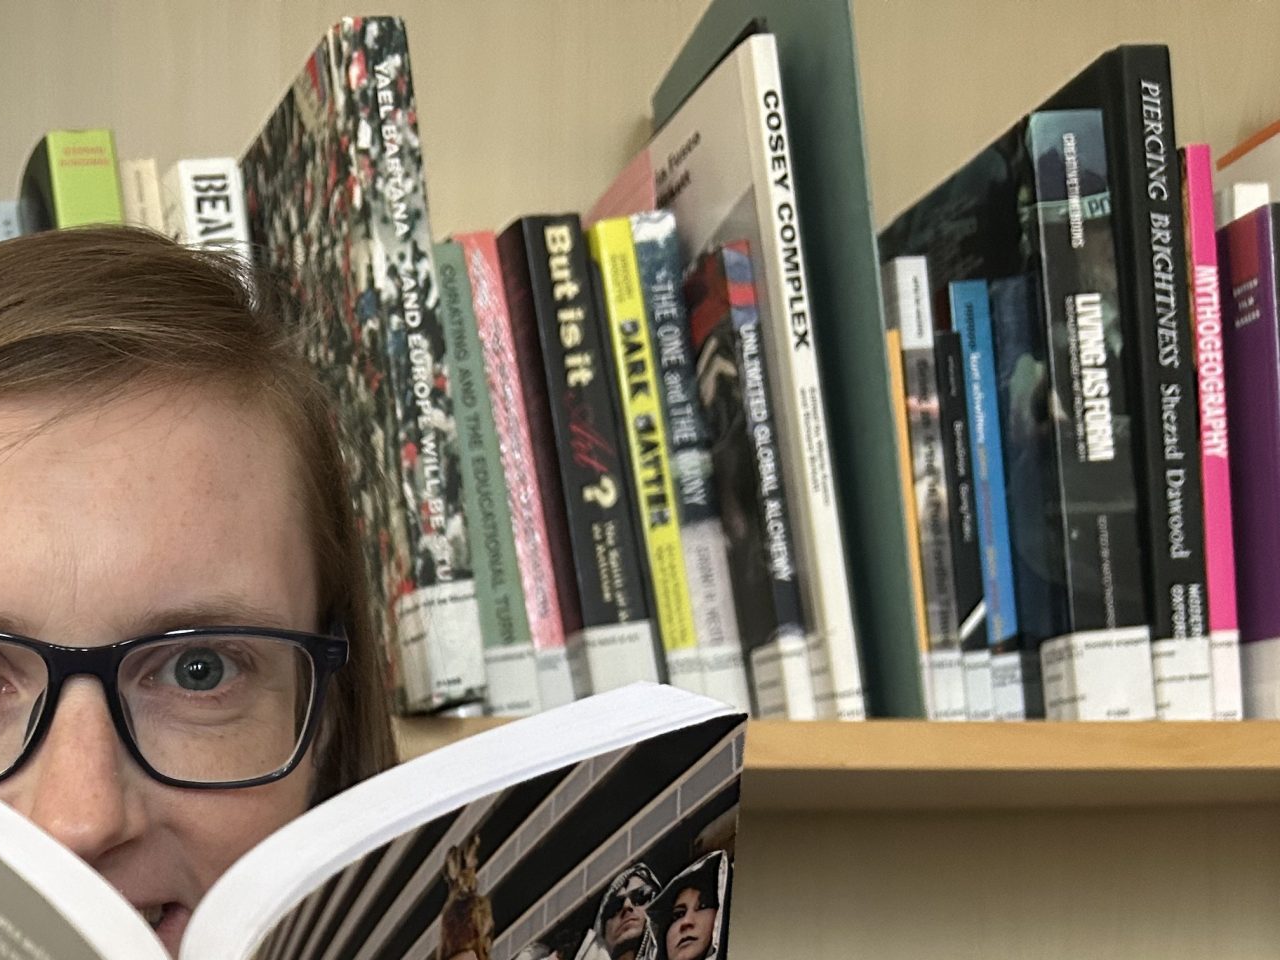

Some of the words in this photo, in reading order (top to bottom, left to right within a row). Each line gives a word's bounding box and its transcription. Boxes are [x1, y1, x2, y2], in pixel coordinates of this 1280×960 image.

[373, 61, 395, 120] YAEL
[1139, 79, 1168, 201] PIERCING
[380, 124, 410, 237] BARTANA
[763, 89, 790, 193] COSEY
[777, 201, 810, 350] COMPLEX
[545, 225, 574, 299] But
[1148, 211, 1179, 368] BRIGHTNESS
[440, 265, 469, 362] CURATING
[561, 307, 584, 347] is
[657, 325, 684, 368] ONE
[1074, 293, 1103, 366] LIVING
[407, 333, 436, 428] EUROPE
[457, 367, 476, 408] AND
[564, 351, 594, 387] it
[620, 320, 654, 399] DARK
[665, 372, 686, 403] and
[740, 323, 767, 422] UNLIMITED
[1080, 367, 1108, 397] AS
[1195, 264, 1227, 459] MYTHOGEOGRAPHY
[465, 413, 484, 450] THE
[667, 406, 695, 444] THE
[1084, 398, 1115, 461] FORM
[1160, 383, 1184, 459] Shezad
[421, 435, 444, 491] WILL
[582, 474, 619, 508] ?
[634, 414, 670, 530] MATTER
[753, 424, 779, 496] GLOBAL
[427, 498, 447, 529] BE
[474, 457, 505, 588] EDUCATIONAL
[765, 500, 795, 581] ALCHEMY
[1165, 469, 1189, 558] Dawood
[494, 594, 513, 644] TURN
